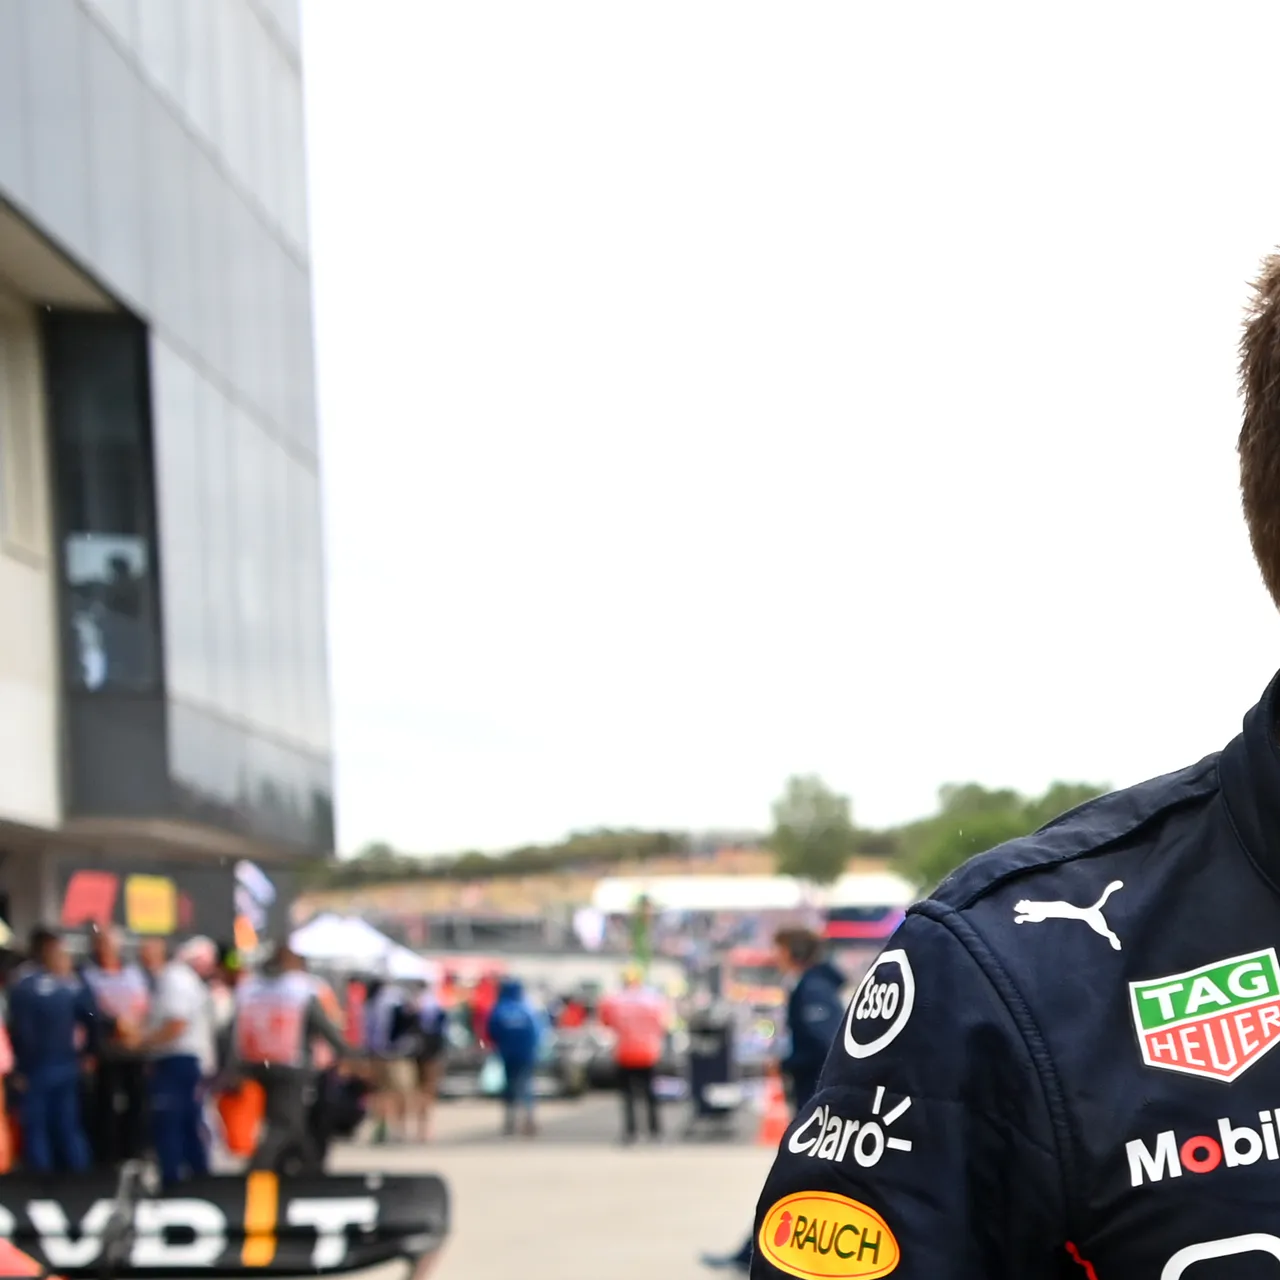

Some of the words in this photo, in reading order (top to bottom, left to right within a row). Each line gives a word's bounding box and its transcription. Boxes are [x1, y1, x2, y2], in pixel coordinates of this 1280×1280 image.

[1141, 962, 1270, 1021] TAG
[788, 1103, 885, 1168] Claro
[790, 1214, 882, 1265] RAUCH
